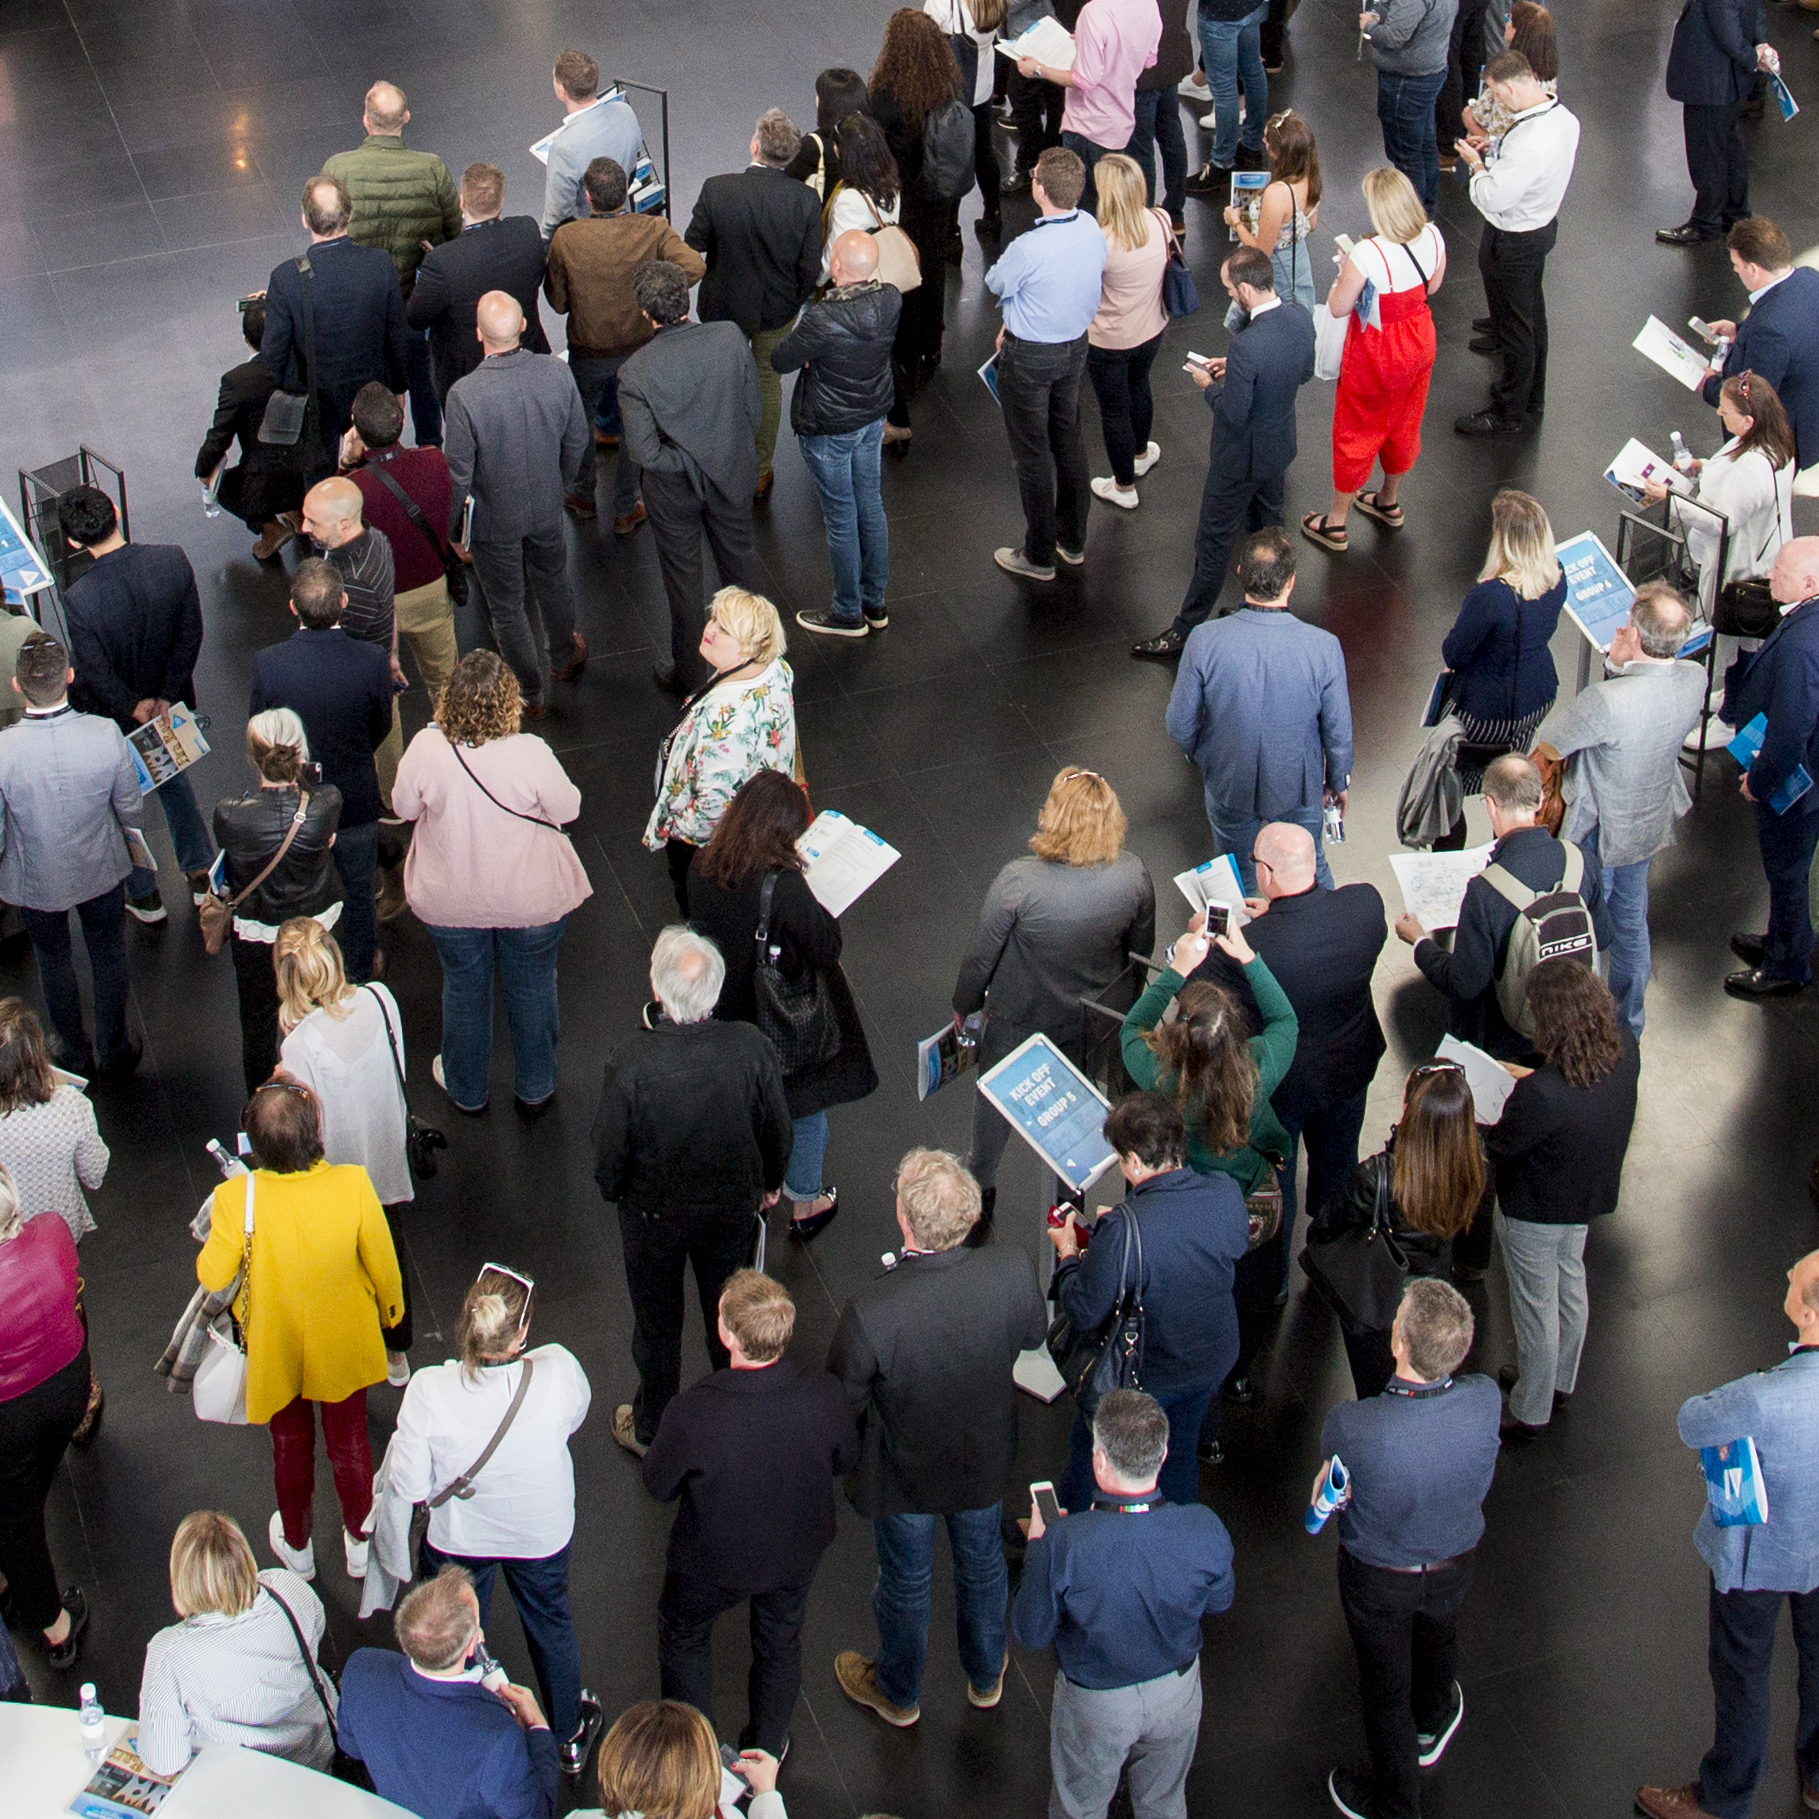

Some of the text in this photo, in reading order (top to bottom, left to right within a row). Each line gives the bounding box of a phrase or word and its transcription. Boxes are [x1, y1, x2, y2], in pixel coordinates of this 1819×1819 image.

[1577, 554, 1595, 569] OFF
[1568, 565, 1597, 585] EVENT
[1575, 583, 1604, 601] GROUP
[1009, 1063, 1051, 1101] KICK OFF
[1024, 1077, 1056, 1107] EVENT
[1037, 1090, 1077, 1127] GROUP 5
